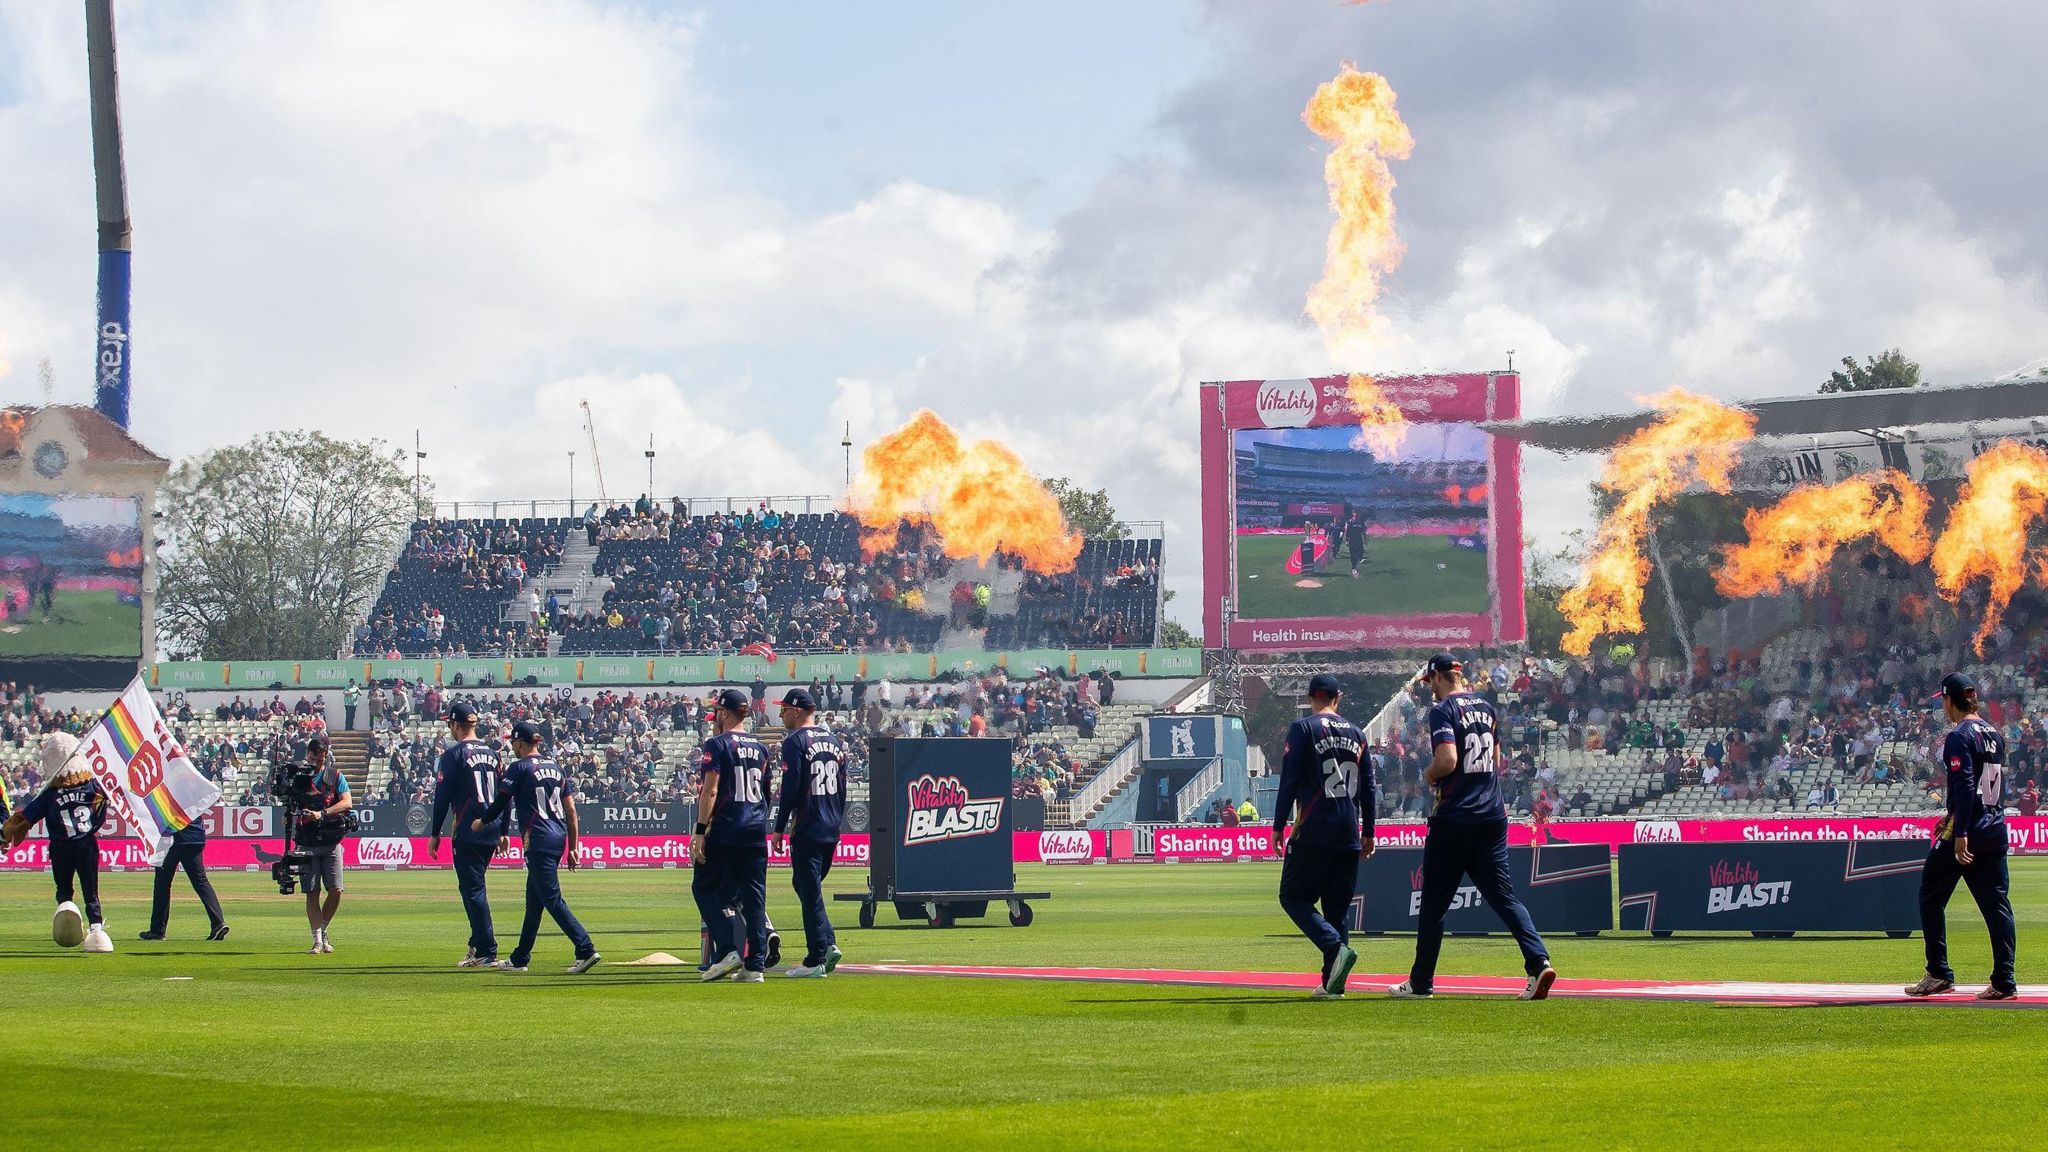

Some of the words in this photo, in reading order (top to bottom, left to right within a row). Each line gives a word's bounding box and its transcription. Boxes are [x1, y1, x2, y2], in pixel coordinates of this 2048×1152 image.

[101, 321, 127, 388] drax
[1259, 387, 1314, 416] Vitality
[1252, 629, 1297, 642] Health
[1162, 656, 1193, 668] PRAVHA
[165, 691, 183, 708] 18
[737, 747, 760, 760] COOK
[1463, 732, 1494, 774] 22
[473, 770, 495, 803] 11
[534, 768, 562, 781] BEARD
[734, 765, 762, 804] 16
[811, 760, 839, 796] 28
[1322, 757, 1359, 799] 20
[56, 792, 86, 806] EDDIE
[535, 786, 565, 820] 14
[912, 780, 965, 813] Vitality
[61, 805, 93, 838] 13
[232, 808, 264, 834] IG
[909, 803, 998, 839] BLAST!
[13, 844, 36, 863] of
[360, 840, 410, 865] Vitality
[1041, 833, 1090, 858] Vitality
[1160, 833, 1233, 856] Sharing
[1237, 832, 1268, 850] the
[1710, 859, 1758, 889] Vitality
[1707, 881, 1792, 914] BLAST!
